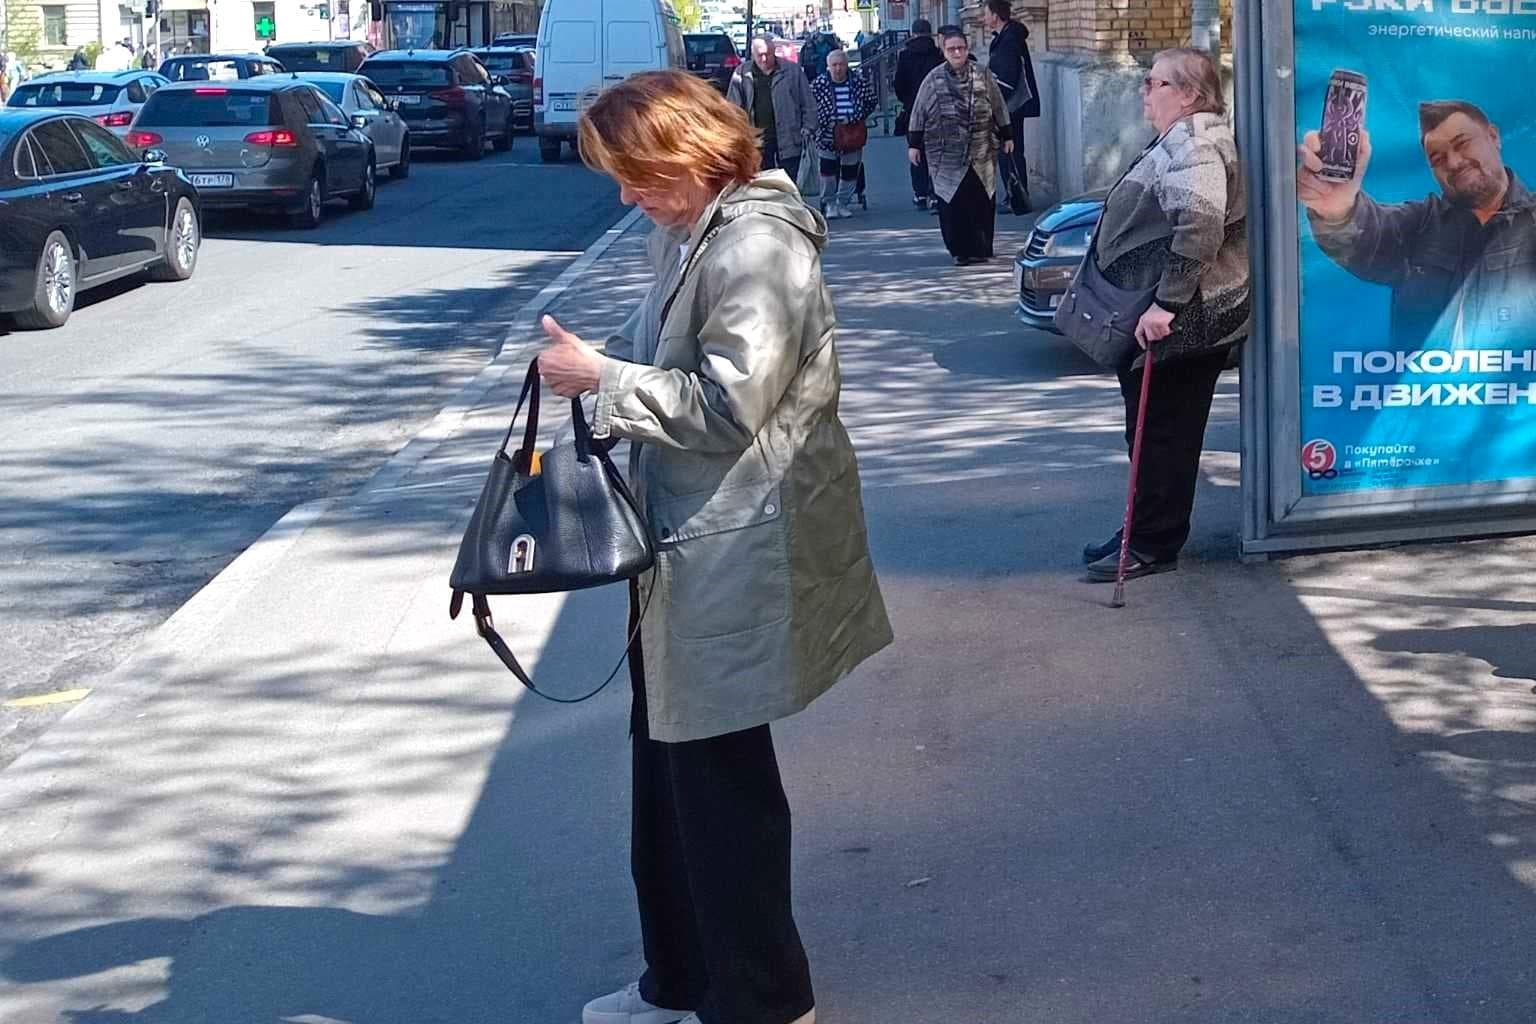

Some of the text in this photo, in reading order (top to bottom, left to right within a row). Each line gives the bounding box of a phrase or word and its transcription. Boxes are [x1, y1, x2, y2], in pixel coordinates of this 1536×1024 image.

[1367, 23, 1499, 40] энергетический
[1312, 384, 1344, 408] В
[1344, 443, 1417, 457] Покупайте
